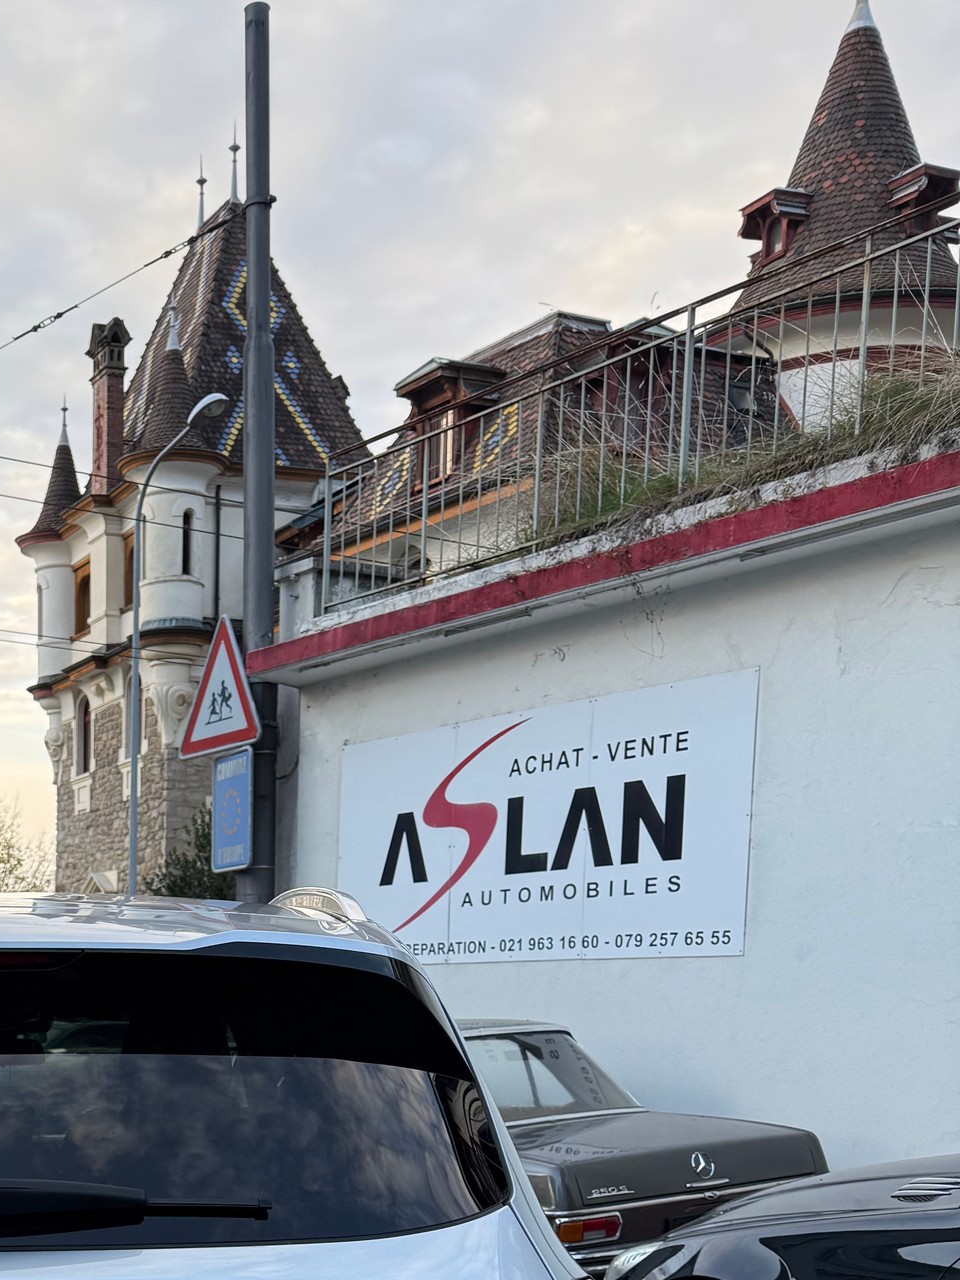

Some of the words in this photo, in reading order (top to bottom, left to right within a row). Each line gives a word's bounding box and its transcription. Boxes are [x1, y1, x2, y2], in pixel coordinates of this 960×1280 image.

[509, 747, 584, 778] ACHAT
[607, 731, 689, 763] VENTE
[379, 717, 686, 933] ASLAN
[461, 875, 682, 908] AUTOMOBILES
[499, 938, 523, 952] 021
[528, 936, 554, 951] 963
[559, 935, 576, 949] 16
[581, 934, 599, 949] 60
[614, 933, 643, 949] 079
[648, 932, 678, 948] 257
[684, 931, 704, 946] 65
[710, 930, 731, 945] 55
